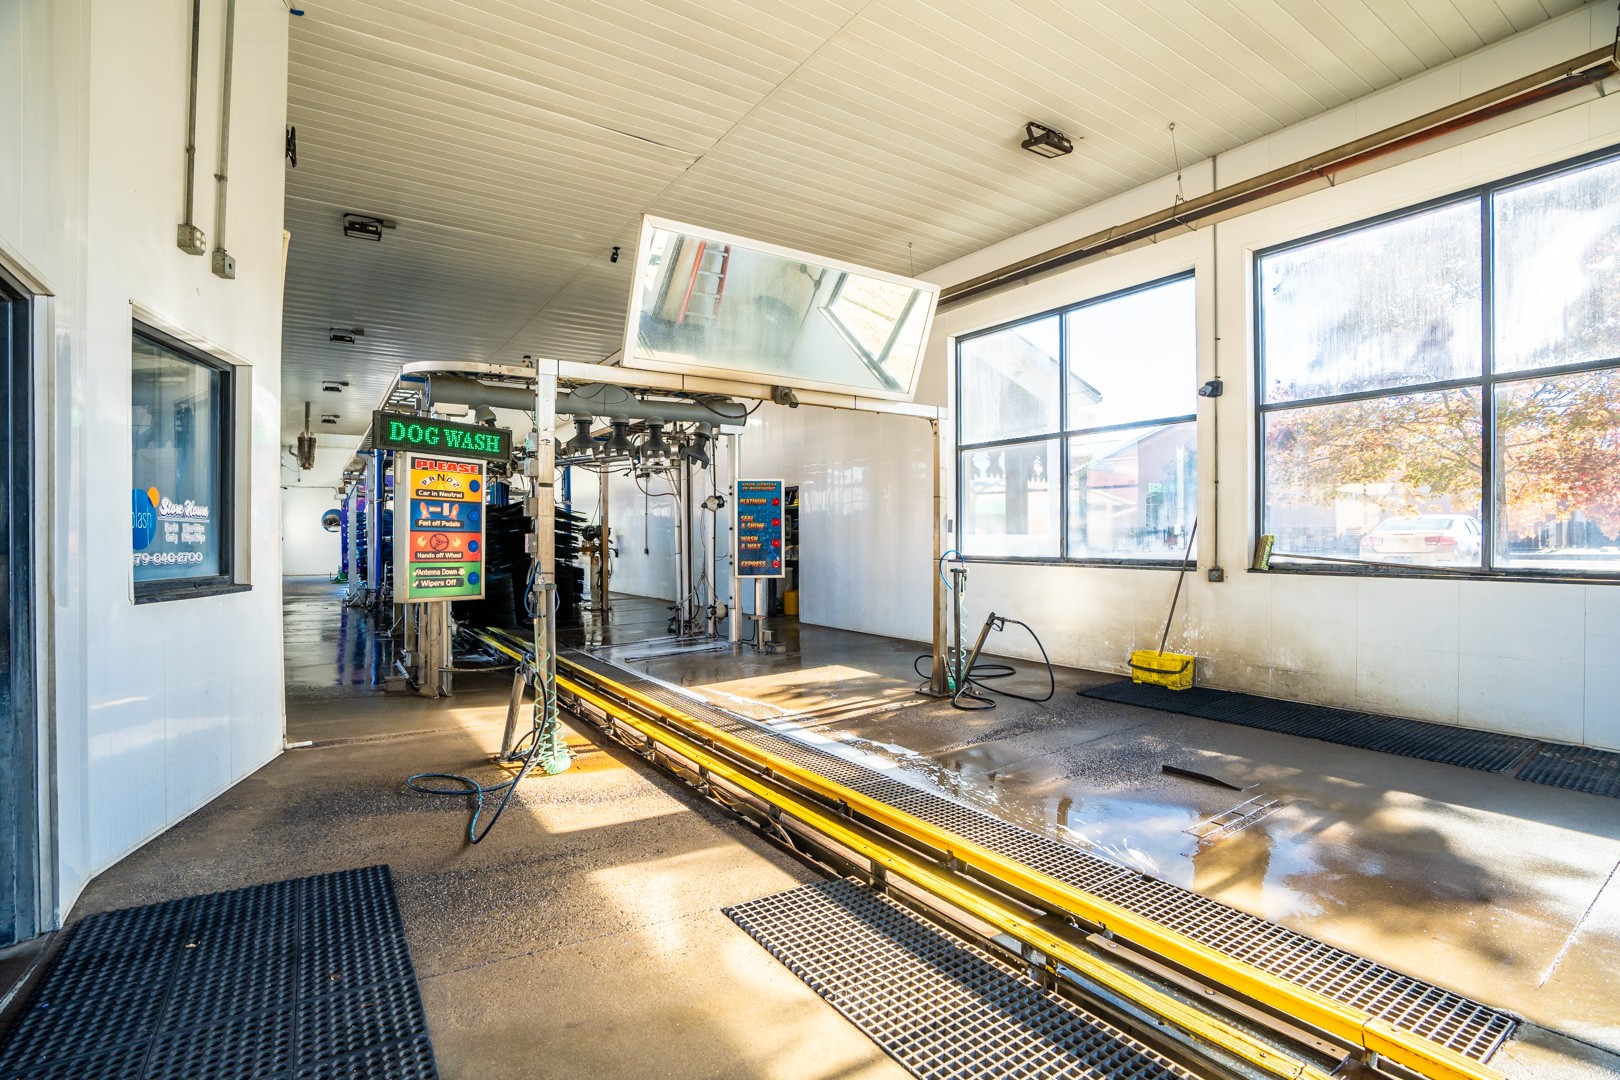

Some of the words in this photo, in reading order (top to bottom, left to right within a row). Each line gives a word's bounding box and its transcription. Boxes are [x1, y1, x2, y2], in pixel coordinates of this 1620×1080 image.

[389, 421, 440, 445] DOG
[443, 428, 500, 453] WASH
[415, 459, 479, 474] PLEASE
[418, 489, 430, 497] Car
[439, 491, 463, 499] Neutral
[159, 496, 184, 518] Store
[132, 552, 203, 566] 79-646-2700
[441, 568, 458, 576] Down
[420, 579, 445, 588] Wipers
[445, 578, 457, 586] Off
